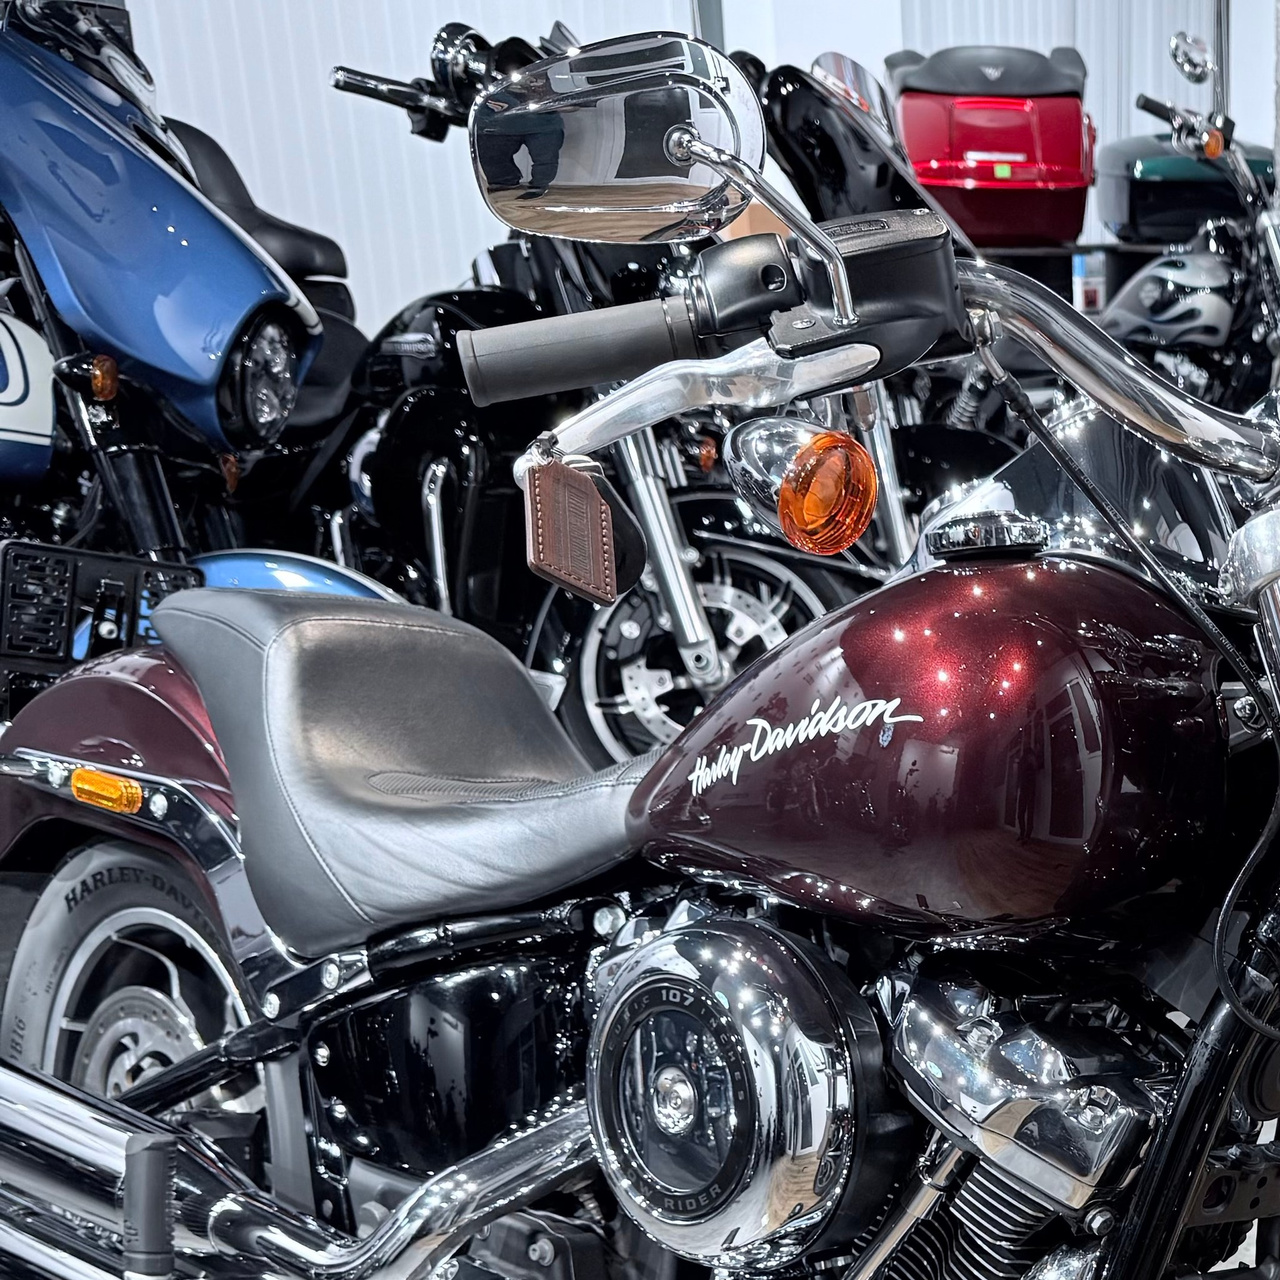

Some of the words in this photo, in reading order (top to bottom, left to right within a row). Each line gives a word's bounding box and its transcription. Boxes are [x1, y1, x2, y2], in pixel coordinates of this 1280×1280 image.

[687, 695, 924, 796] Harley-Davidson
[661, 989, 695, 1006] 107
[664, 1184, 722, 1211] RIDER
